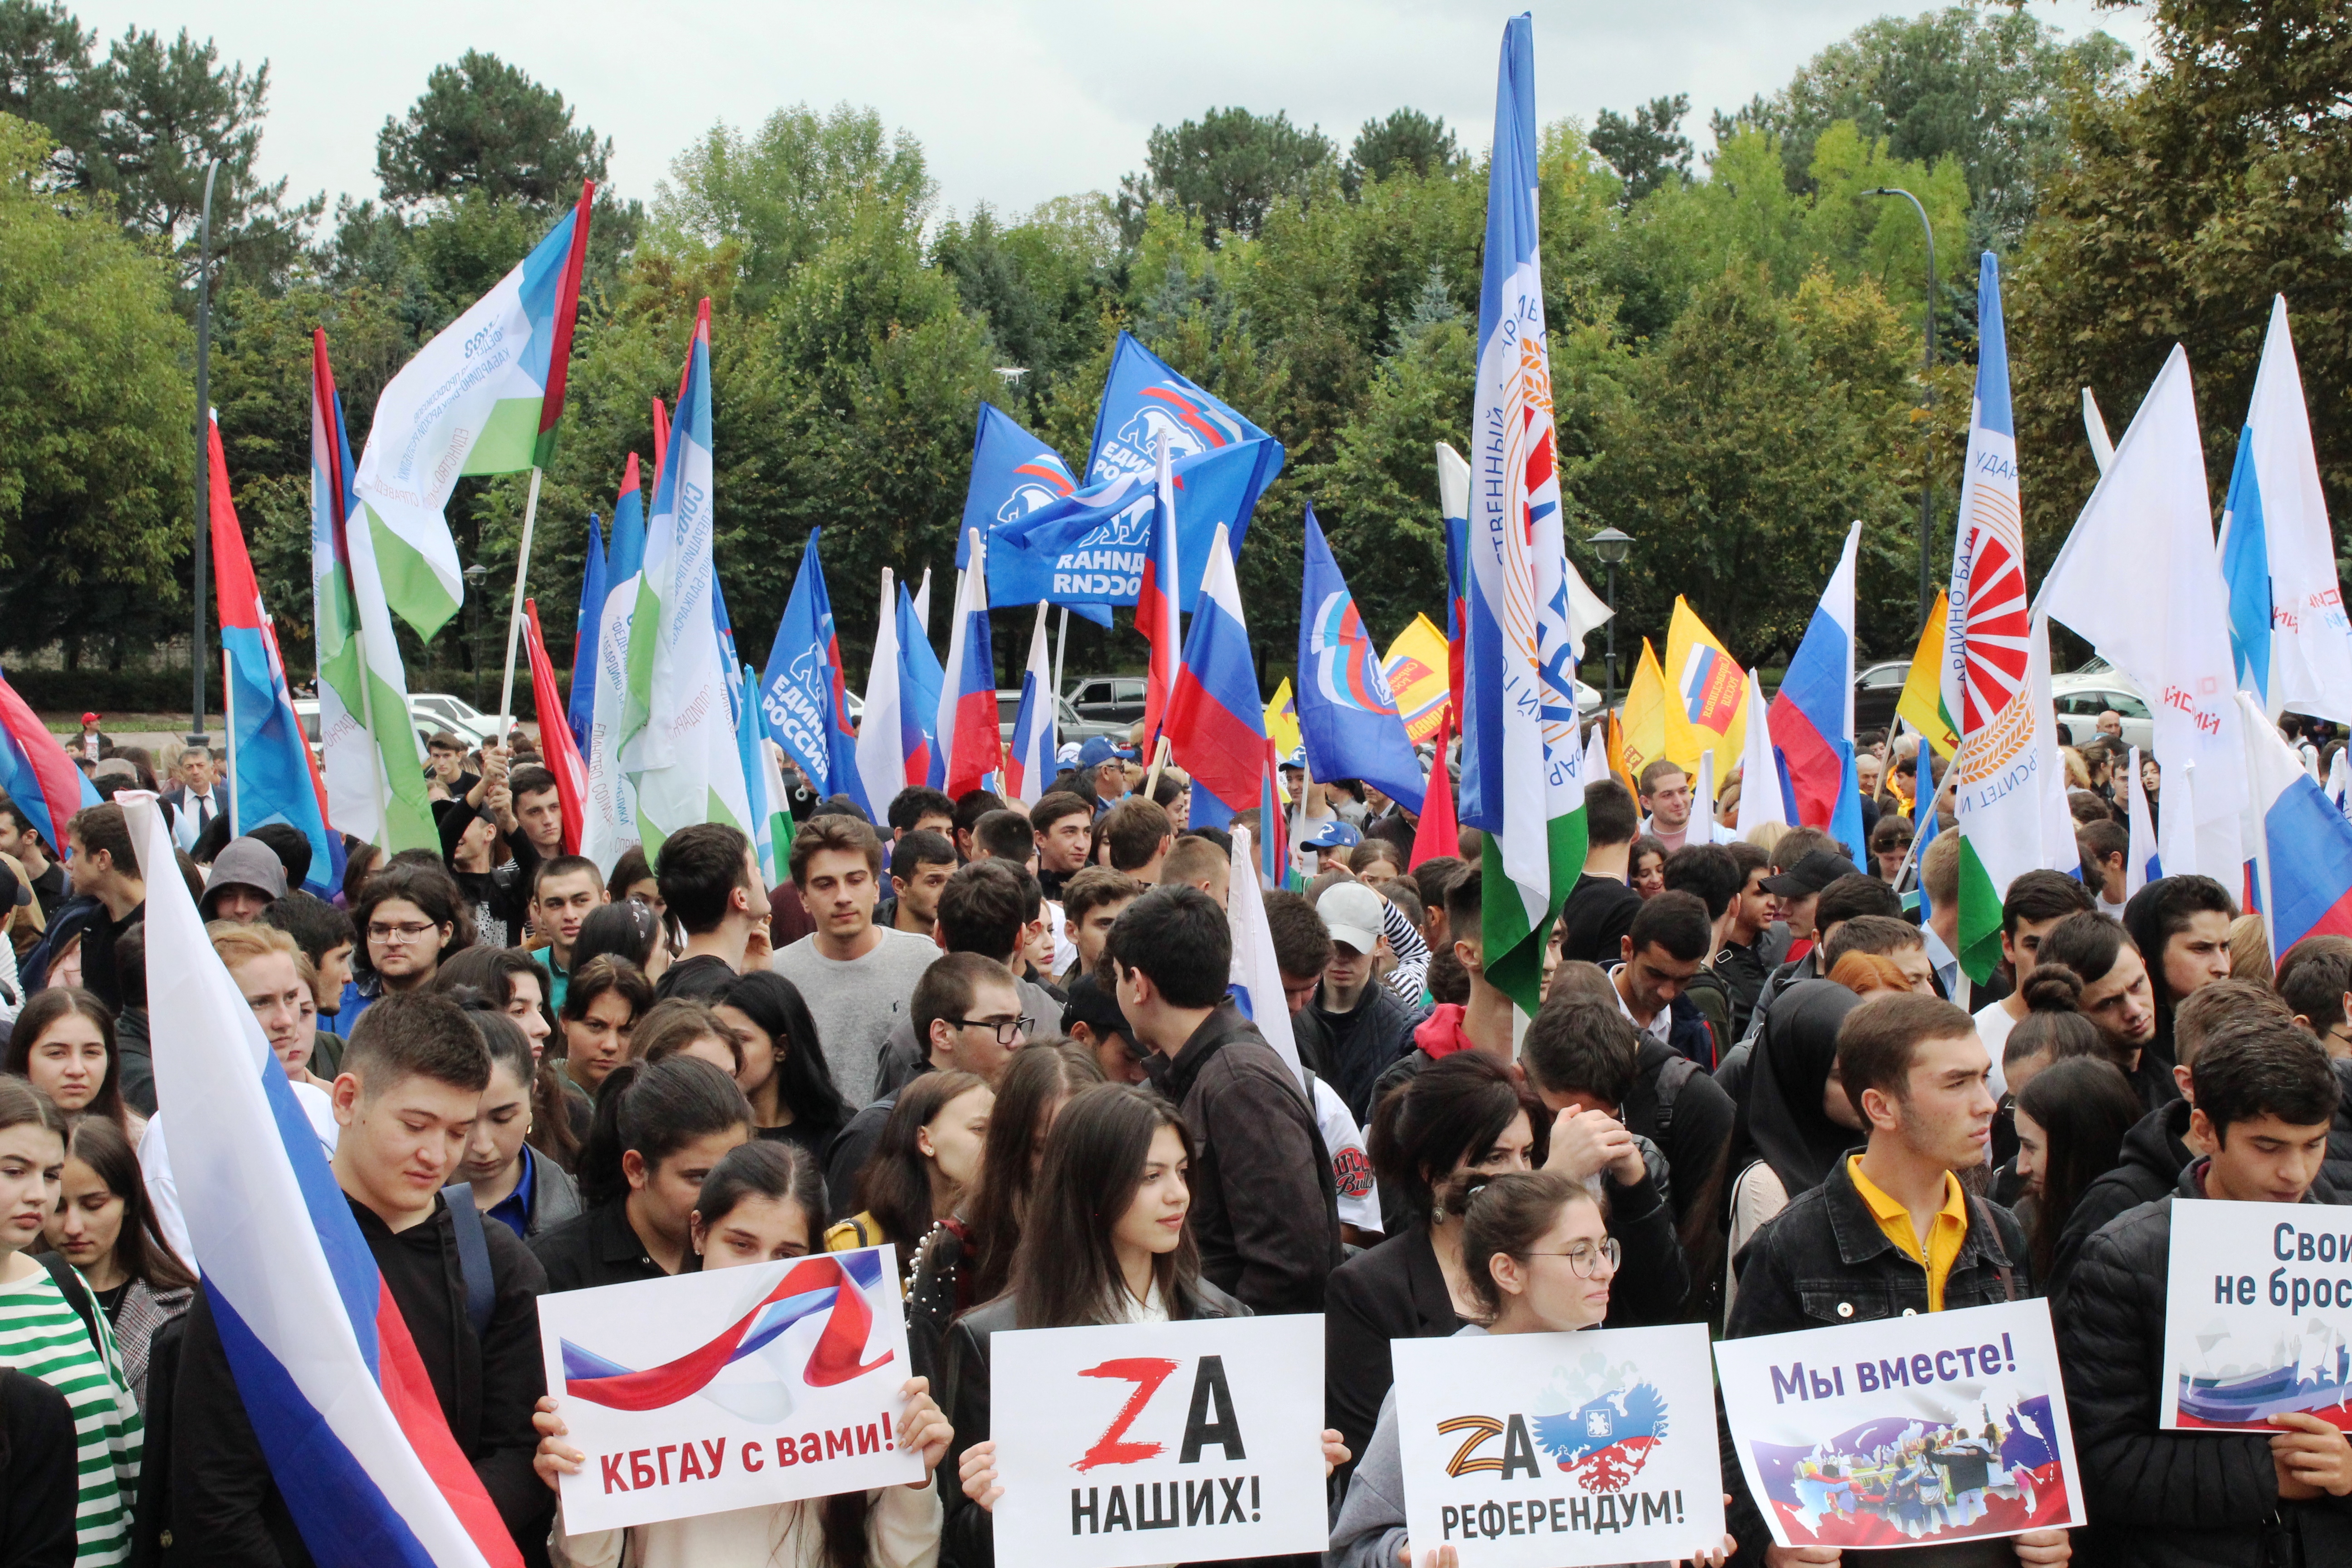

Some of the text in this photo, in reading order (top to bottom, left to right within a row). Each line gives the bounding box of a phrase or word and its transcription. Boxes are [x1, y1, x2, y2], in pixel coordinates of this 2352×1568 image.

[762, 694, 828, 783] РОССИЯ
[2215, 1266, 2352, 1316] не брос
[1769, 1332, 2016, 1404] Мы вместе!
[600, 1412, 894, 1494] КБГАУ с вами!
[1072, 1475, 1260, 1535] НАШИХ!
[1442, 1490, 1684, 1540] РЕФЕРЕНДУМ!
